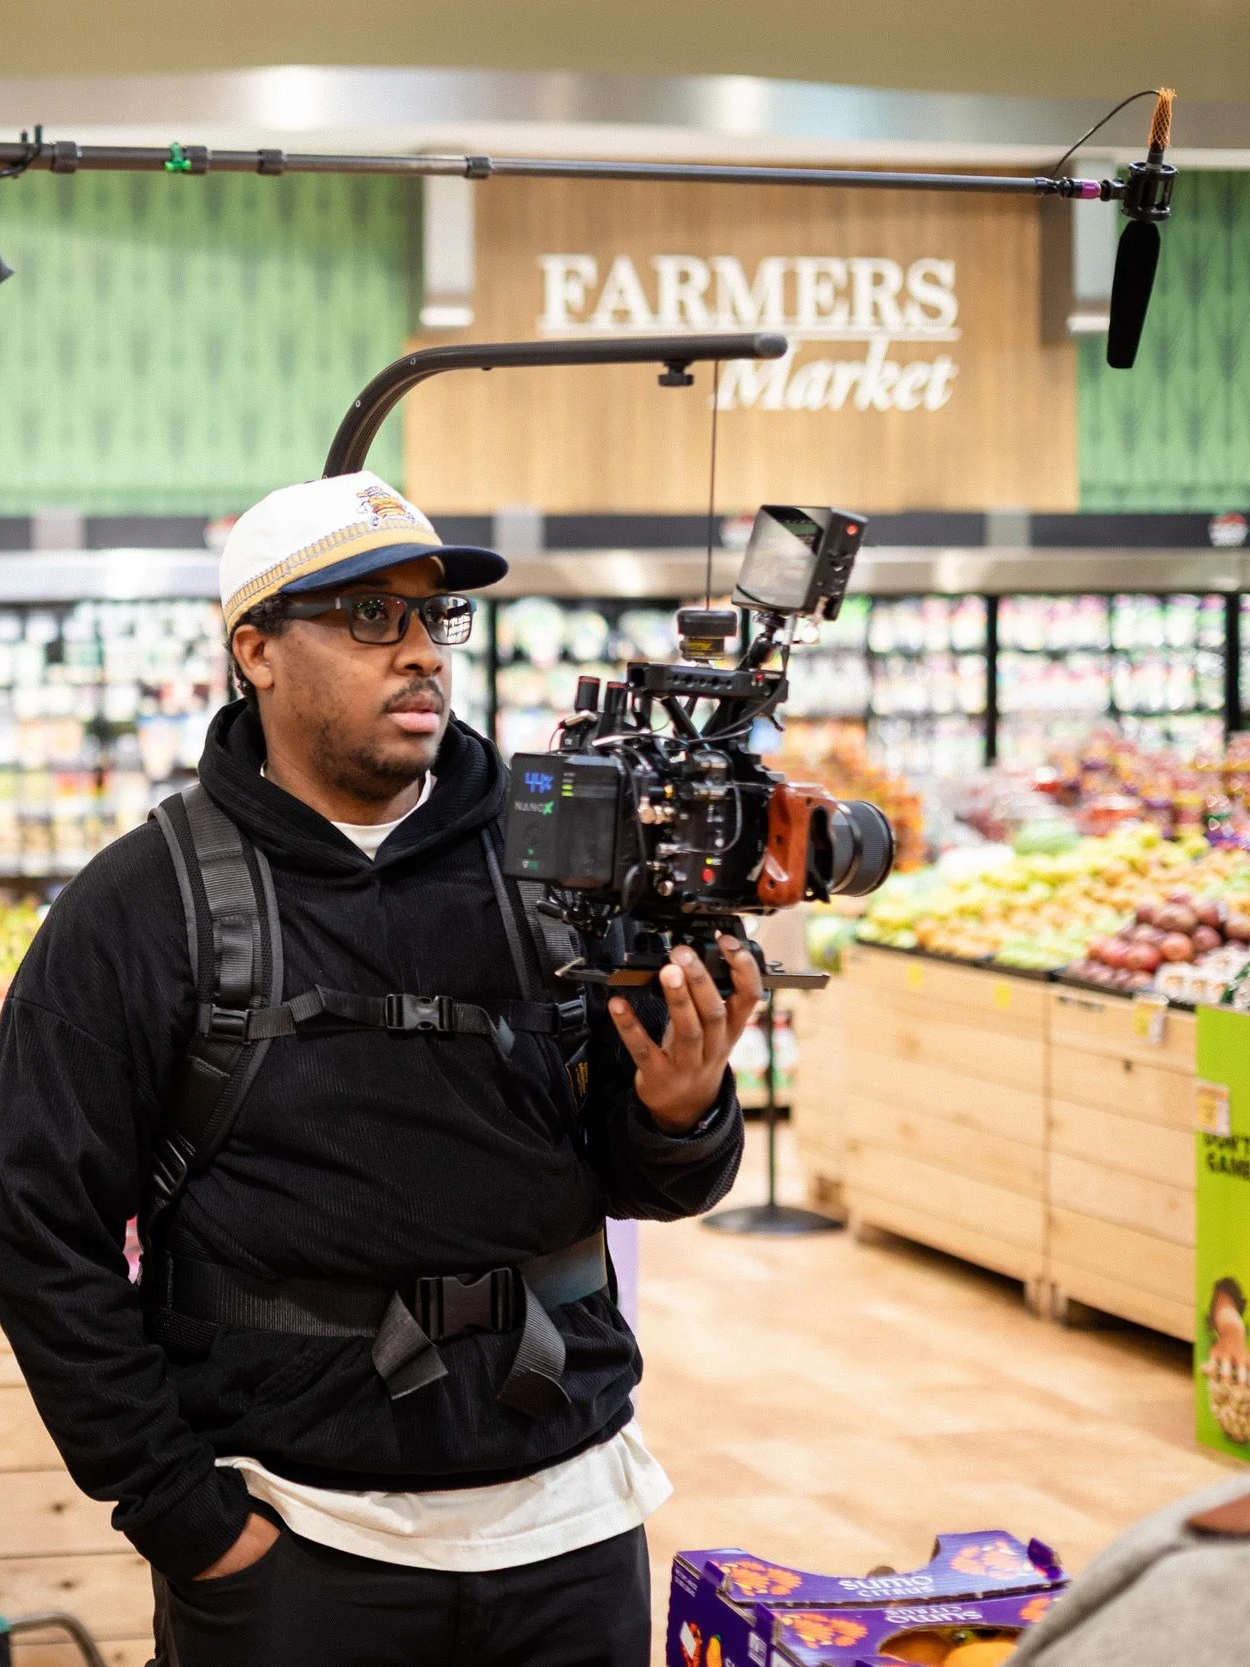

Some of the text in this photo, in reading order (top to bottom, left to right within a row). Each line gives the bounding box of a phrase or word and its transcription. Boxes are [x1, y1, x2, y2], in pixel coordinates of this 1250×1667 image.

[535, 253, 959, 331] FARMERS
[708, 333, 958, 412] Market
[858, 1584, 935, 1598] CITRUS
